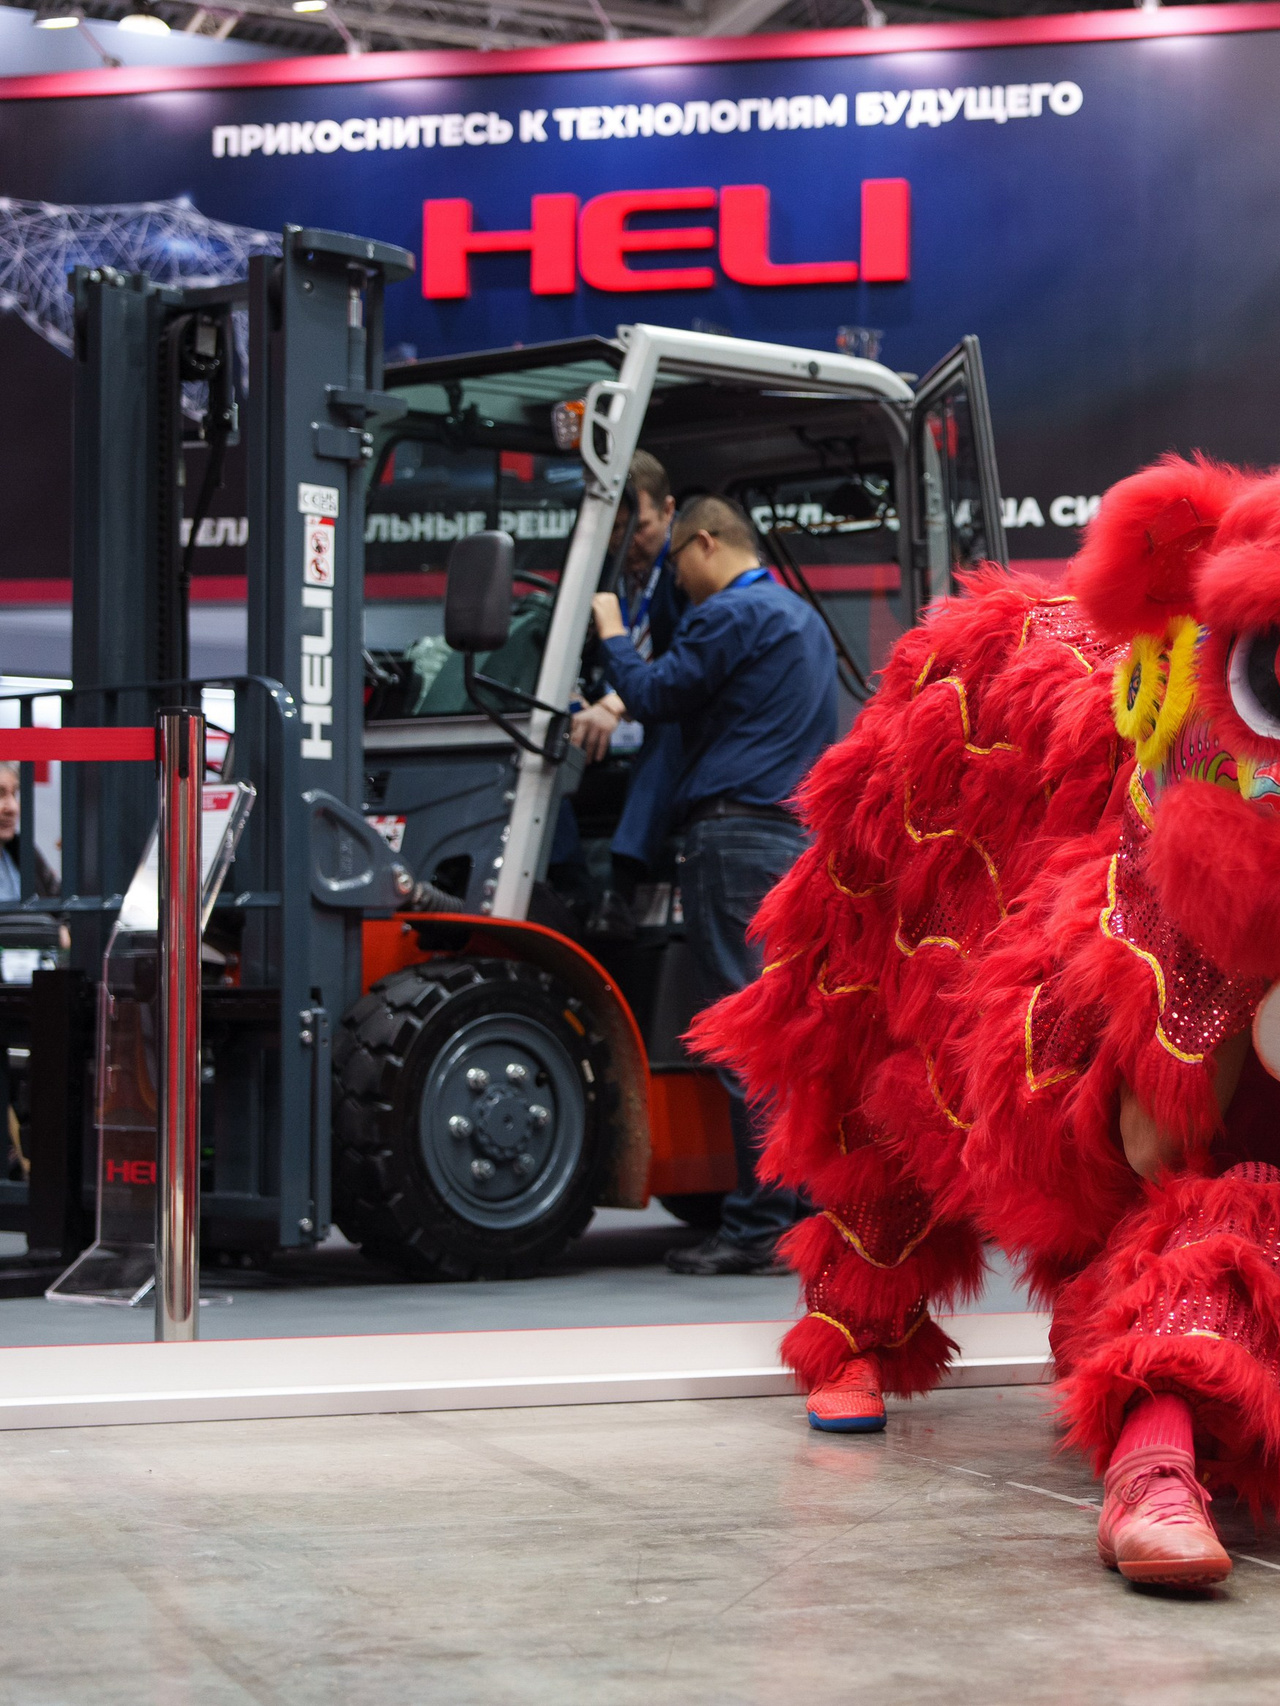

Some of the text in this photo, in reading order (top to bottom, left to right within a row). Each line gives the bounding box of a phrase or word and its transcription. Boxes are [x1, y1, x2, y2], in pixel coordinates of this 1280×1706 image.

[212, 80, 1084, 158] ПРИКОСНИТЕСЬ К ТЕХНОЛОГИЯМ БУДУЩЕГО
[422, 177, 909, 299] HELI
[301, 586, 334, 760] HELI
